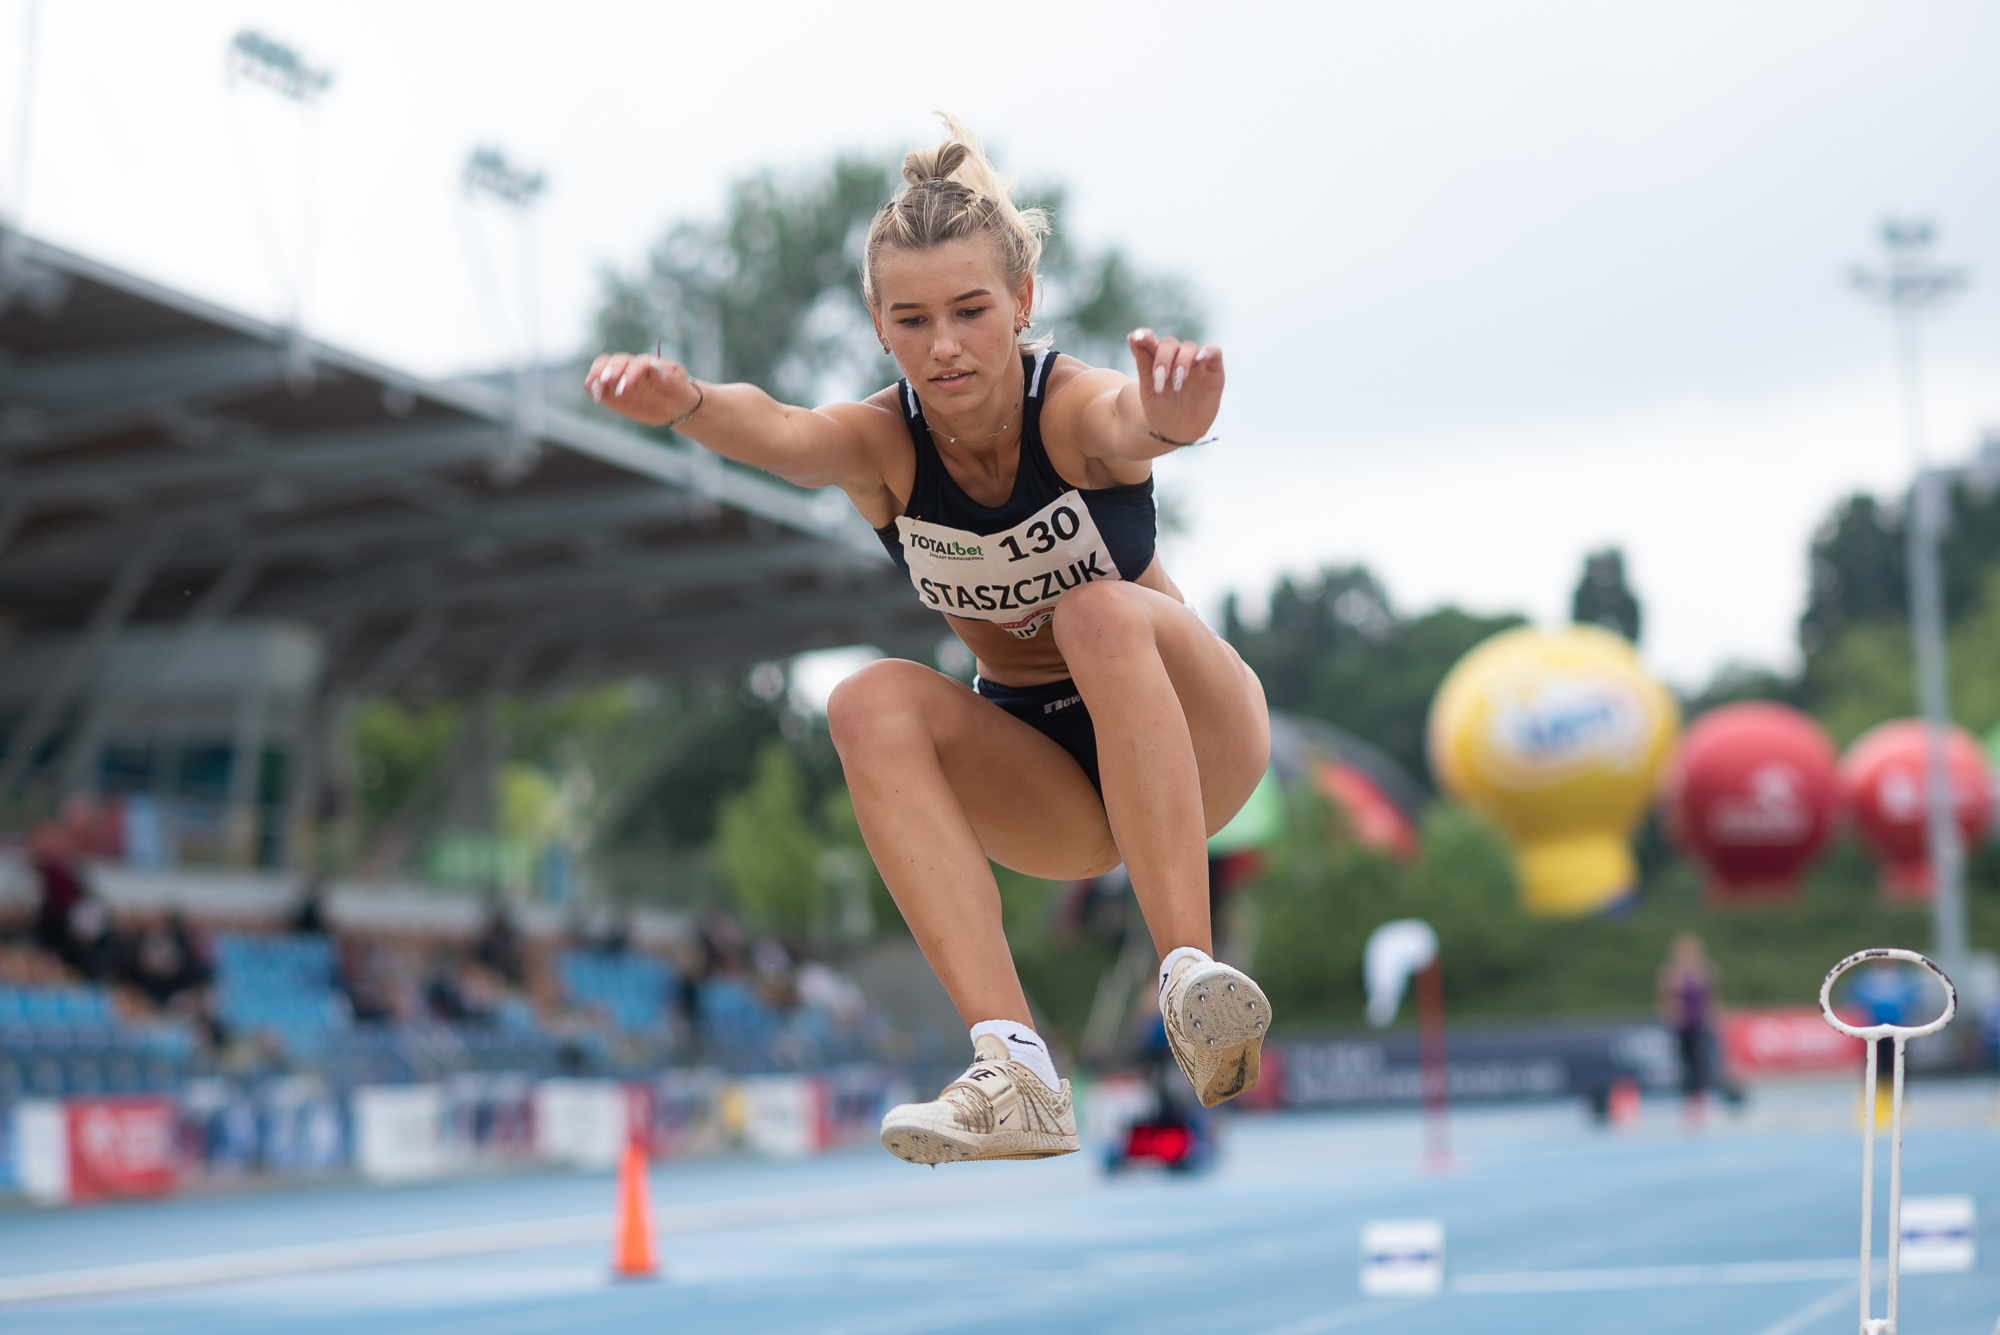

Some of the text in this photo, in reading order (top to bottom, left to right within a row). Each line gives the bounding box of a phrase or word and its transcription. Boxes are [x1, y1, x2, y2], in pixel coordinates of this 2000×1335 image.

[910, 532, 984, 556] TOTALbet
[998, 505, 1080, 563] 130
[919, 550, 1108, 611] STASZCZUK
